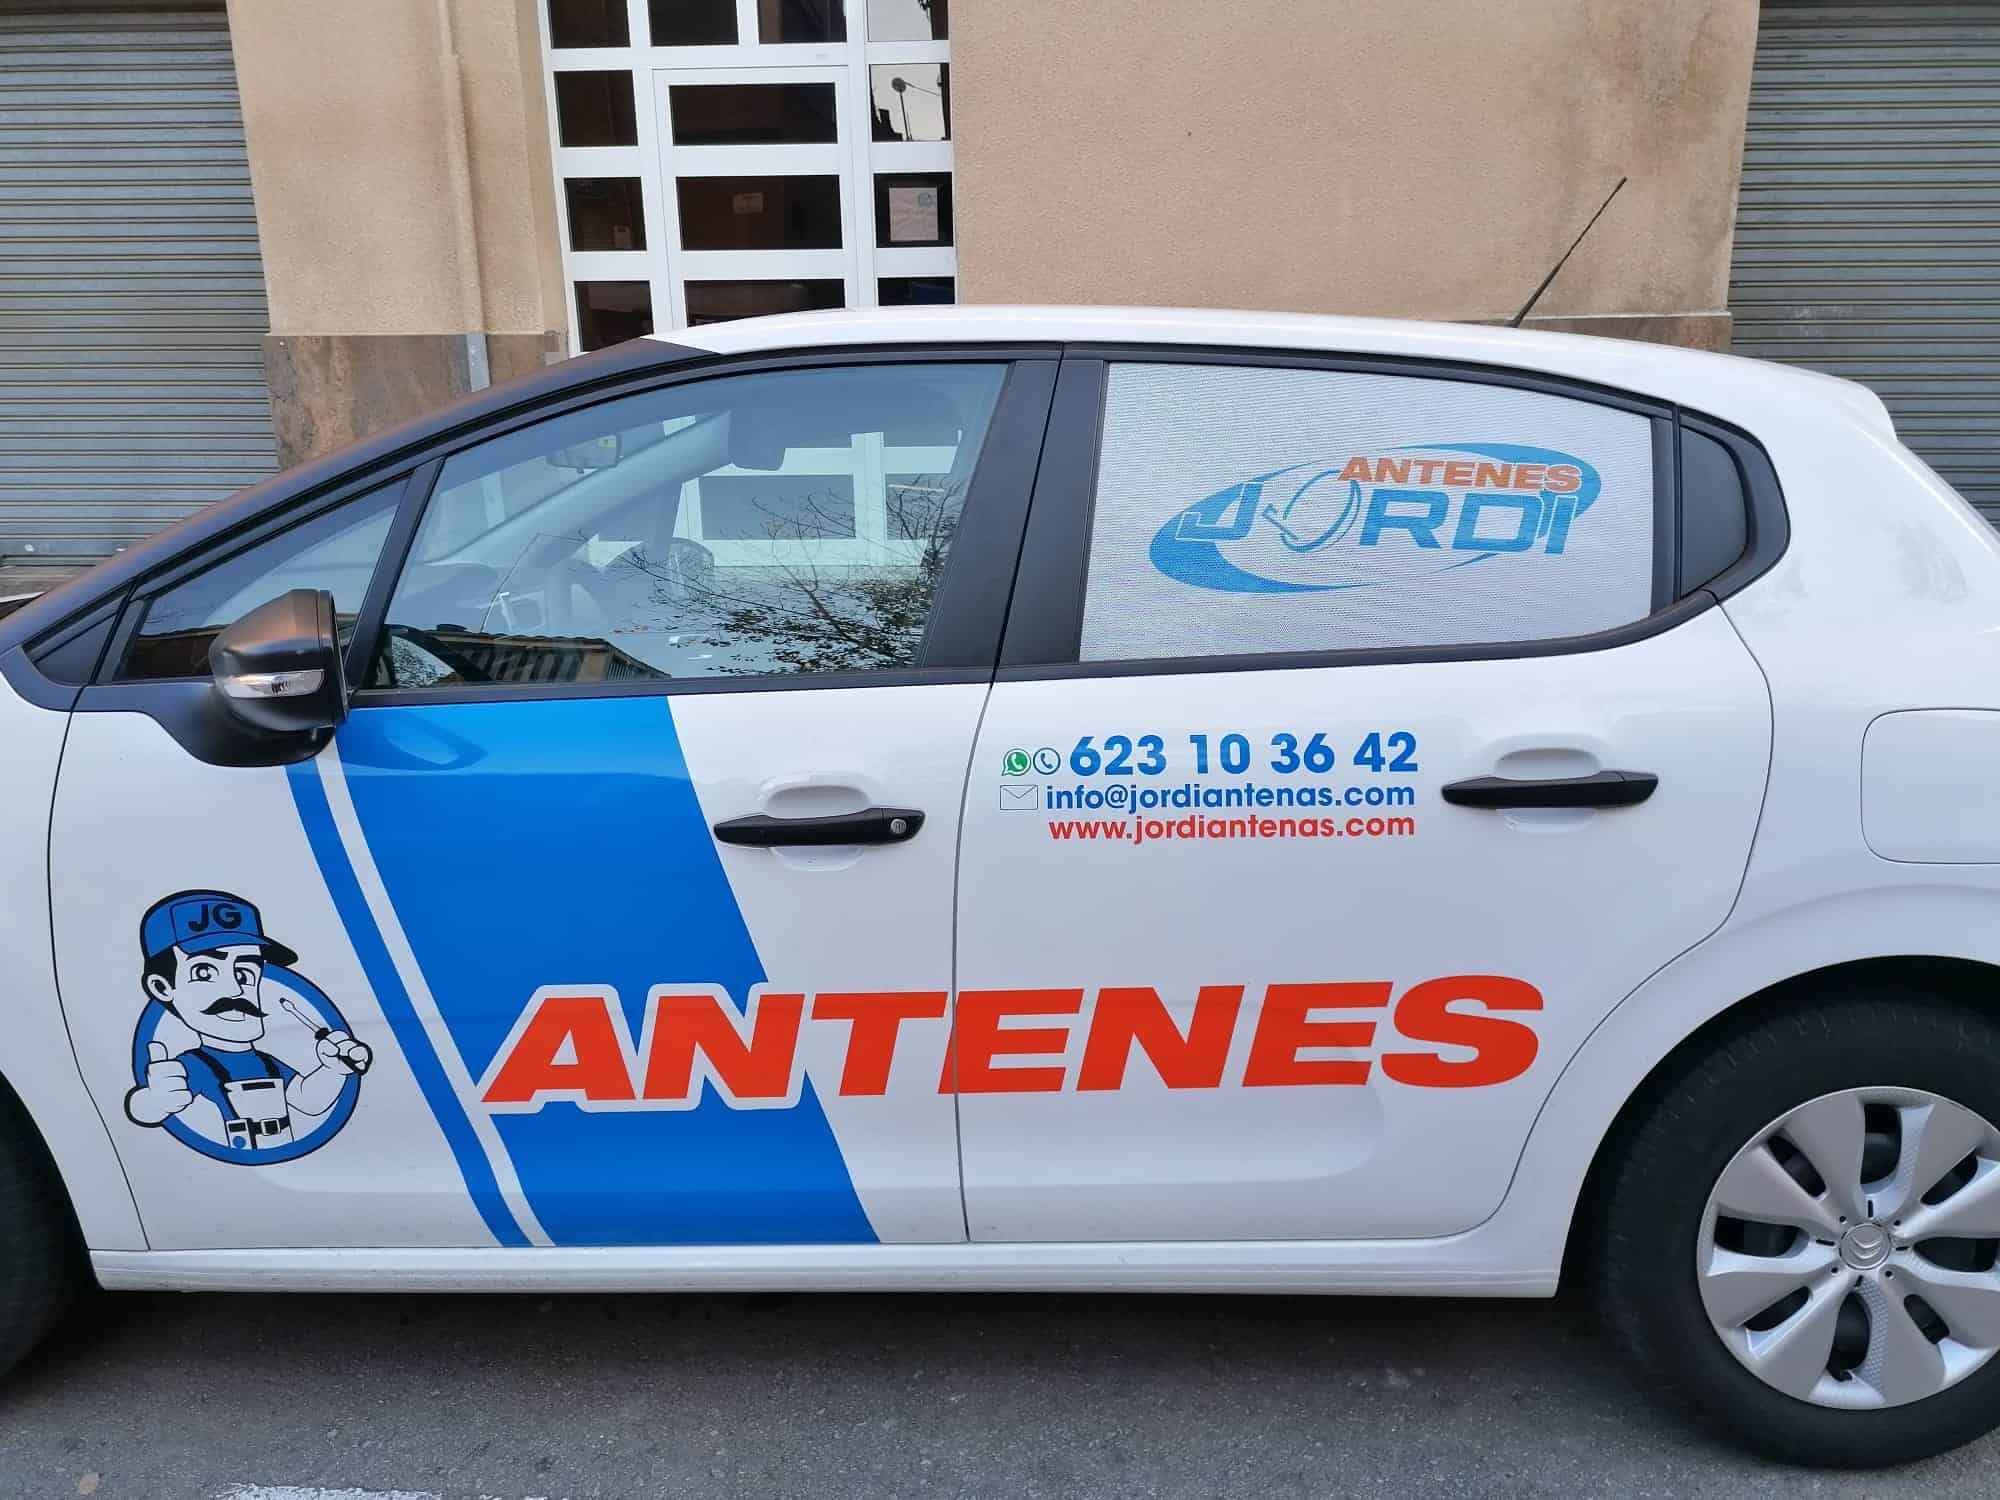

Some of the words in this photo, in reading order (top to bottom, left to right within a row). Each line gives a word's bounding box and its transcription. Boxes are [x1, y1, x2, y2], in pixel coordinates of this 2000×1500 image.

[1338, 456, 1582, 492] ANTENES
[1175, 470, 1579, 555] JORDI
[1069, 735, 1167, 777] 623
[1189, 733, 1251, 775] 10
[1269, 732, 1336, 775] 36
[1352, 731, 1420, 773] 42
[1046, 783, 1416, 814] info@jordiantenas.com
[1049, 815, 1416, 845] www.jordiantenas.com
[188, 902, 243, 932] JG
[482, 975, 1544, 1103] ANTENES
